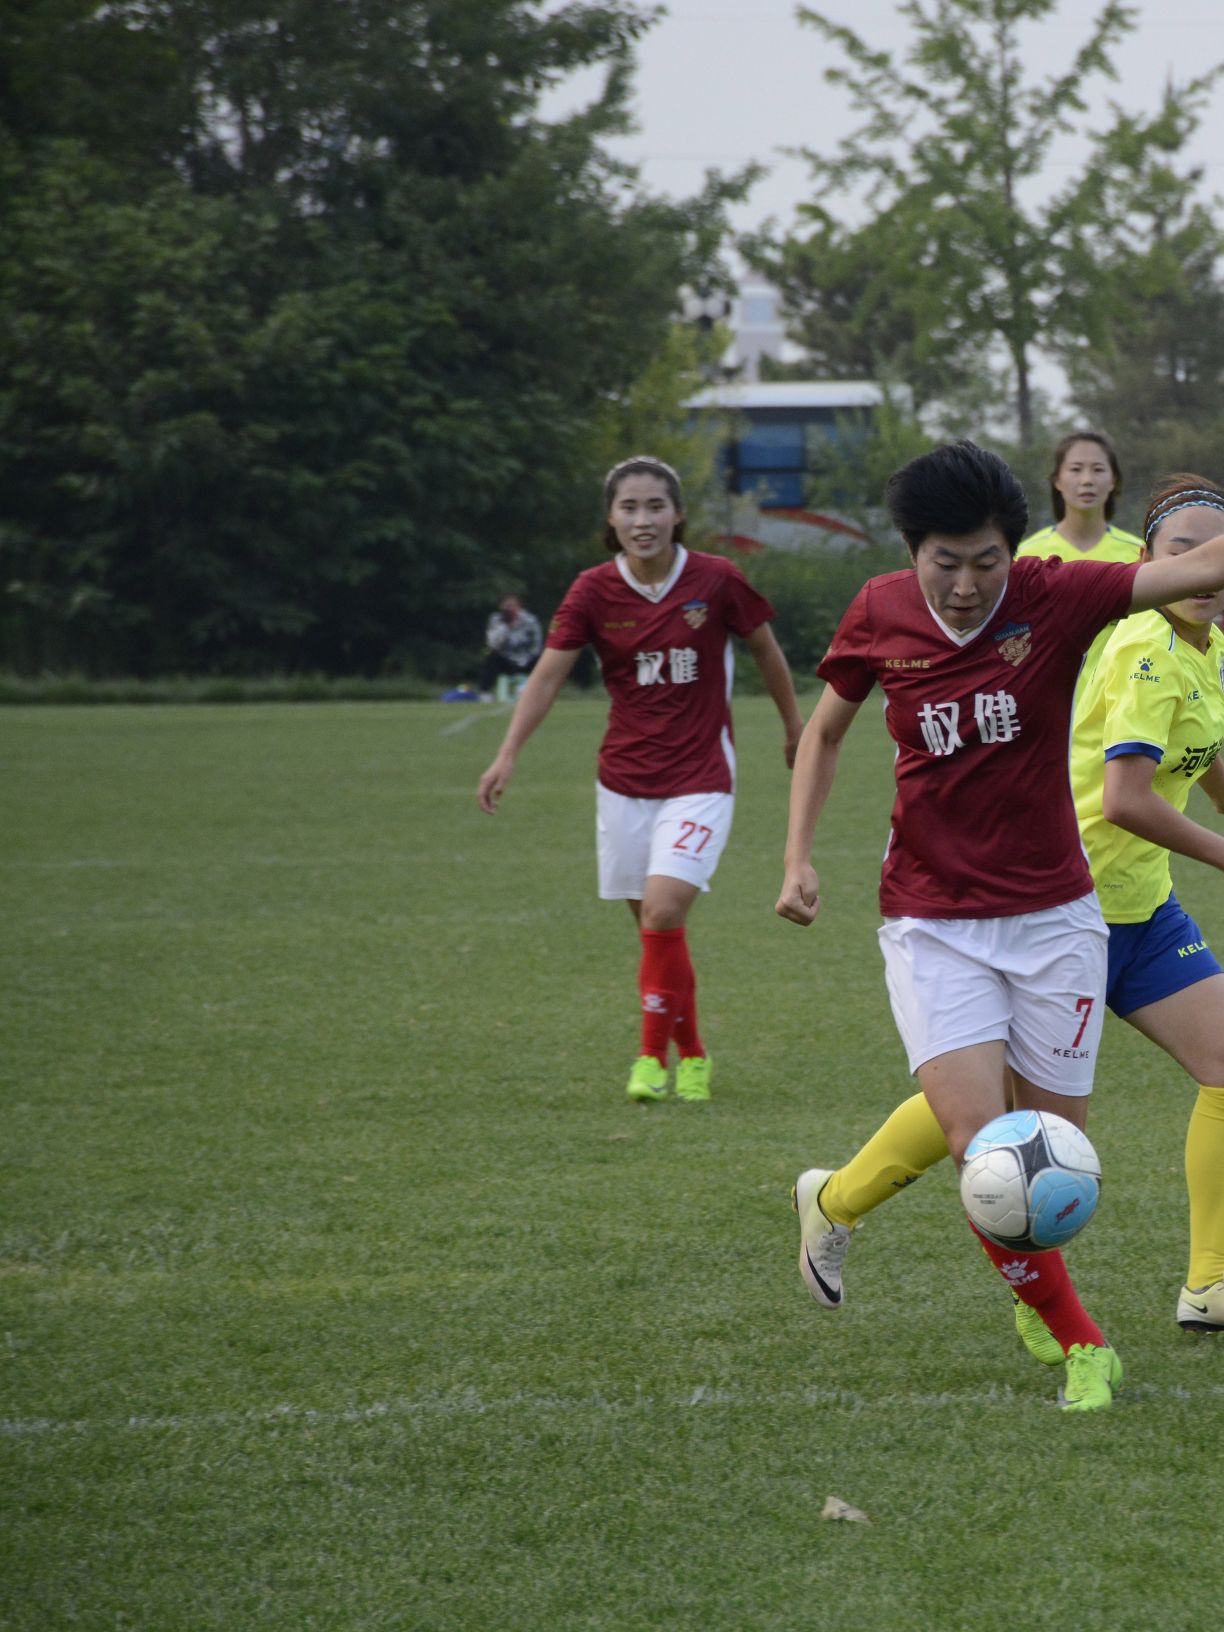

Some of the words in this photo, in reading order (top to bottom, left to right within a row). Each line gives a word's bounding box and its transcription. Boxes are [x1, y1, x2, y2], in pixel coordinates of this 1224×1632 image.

[634, 647, 698, 686] 权健
[885, 659, 930, 669] KELME
[917, 690, 1021, 756] 权健
[672, 820, 713, 854] 27
[1075, 998, 1095, 1048] 7
[1053, 1047, 1089, 1059] KELME
